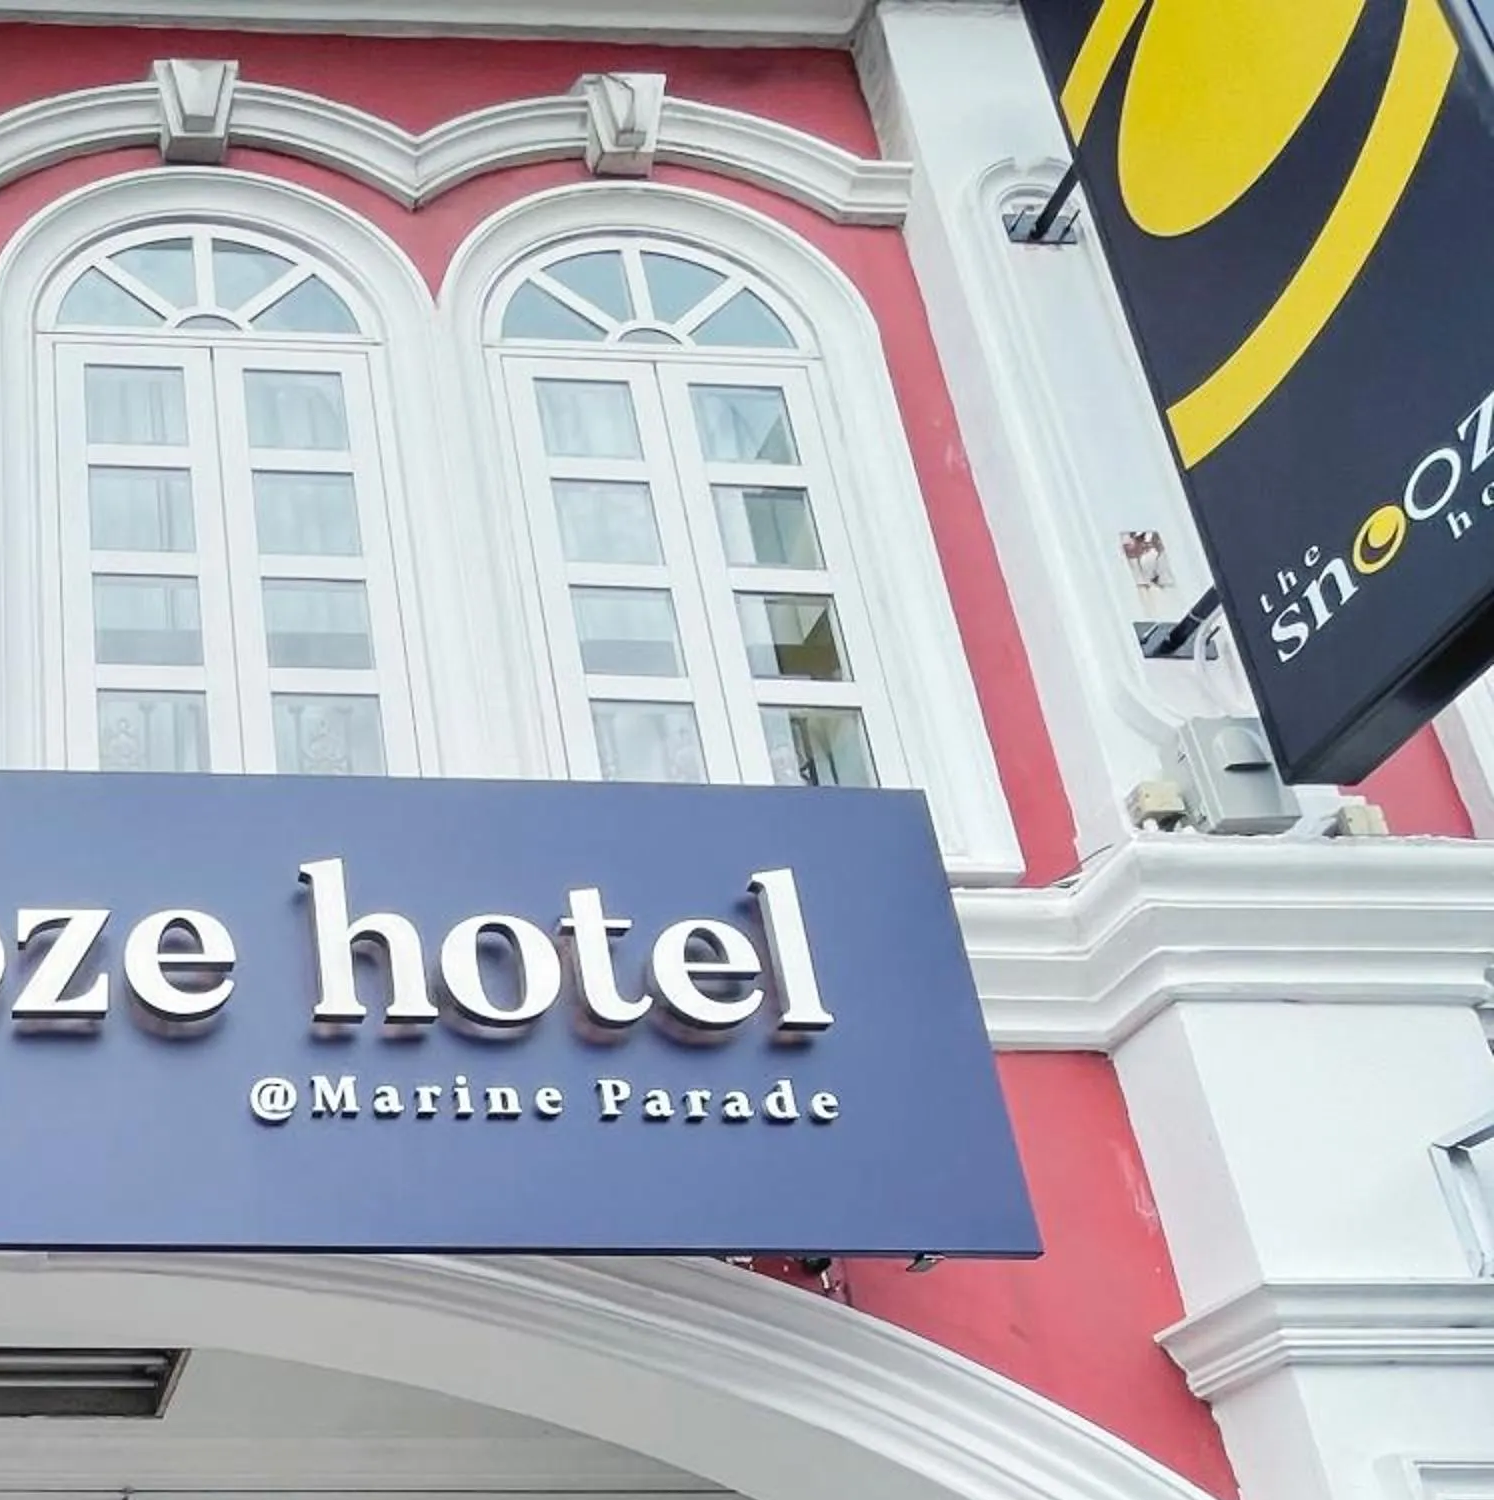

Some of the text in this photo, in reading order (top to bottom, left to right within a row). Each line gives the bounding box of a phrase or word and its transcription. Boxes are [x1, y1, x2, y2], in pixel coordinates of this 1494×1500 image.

[1260, 545, 1320, 614] the
[297, 857, 836, 1034] hotel
[596, 1077, 843, 1124] Parade
